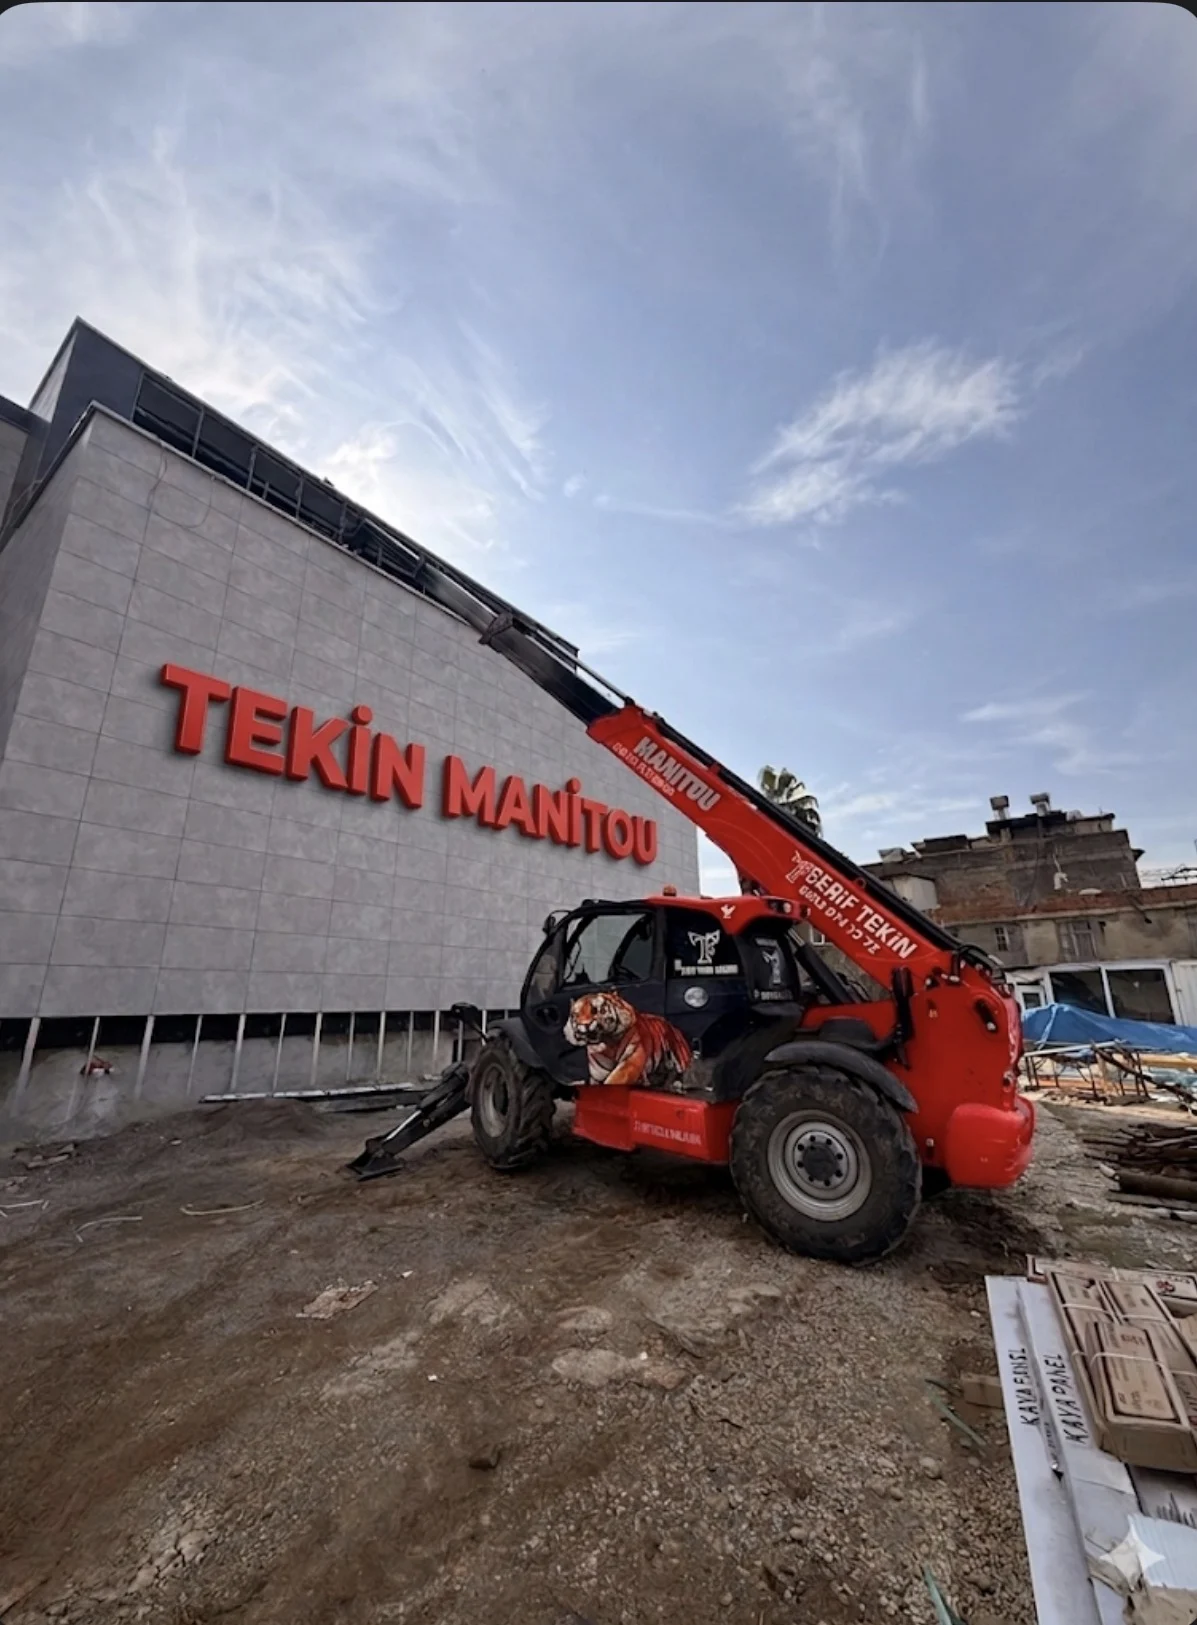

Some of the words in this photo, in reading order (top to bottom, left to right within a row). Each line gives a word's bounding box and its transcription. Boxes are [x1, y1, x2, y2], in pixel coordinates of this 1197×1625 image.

[633, 736, 721, 811] MANITOU
[1016, 1388, 1040, 1426] KAYA
[1055, 1398, 1090, 1444] KAYA
